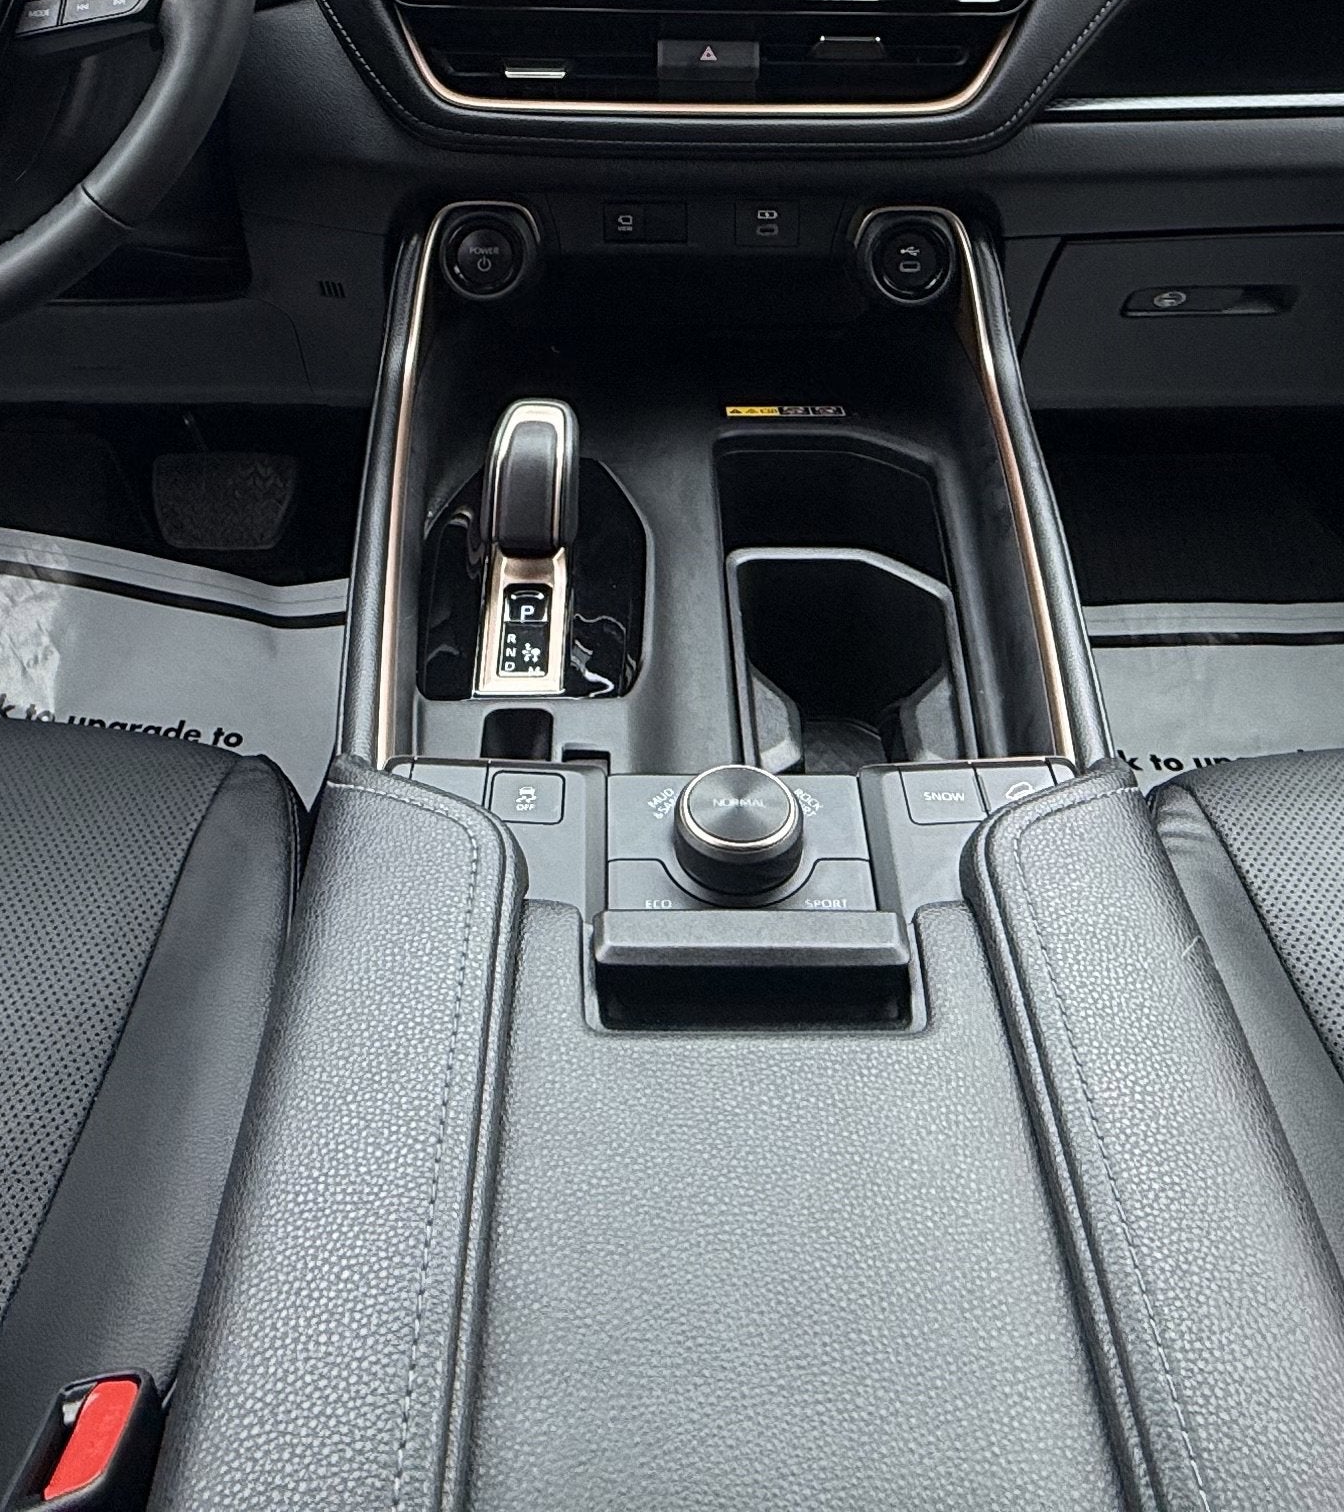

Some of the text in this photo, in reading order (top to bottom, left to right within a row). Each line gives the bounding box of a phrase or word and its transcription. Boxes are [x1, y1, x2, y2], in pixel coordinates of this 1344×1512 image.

[28, 8, 50, 17] MODE
[470, 247, 499, 255] POWER
[520, 604, 535, 623] P
[506, 633, 517, 644] R
[505, 647, 517, 657] N
[504, 661, 516, 671] D
[212, 727, 244, 748] to
[1149, 754, 1184, 771] to
[647, 787, 675, 808] MUD
[713, 797, 767, 808] NORMAL
[793, 788, 821, 811] ROCK
[923, 791, 966, 803] SNOW
[645, 899, 673, 909] ECO
[804, 898, 848, 909] SPORT
